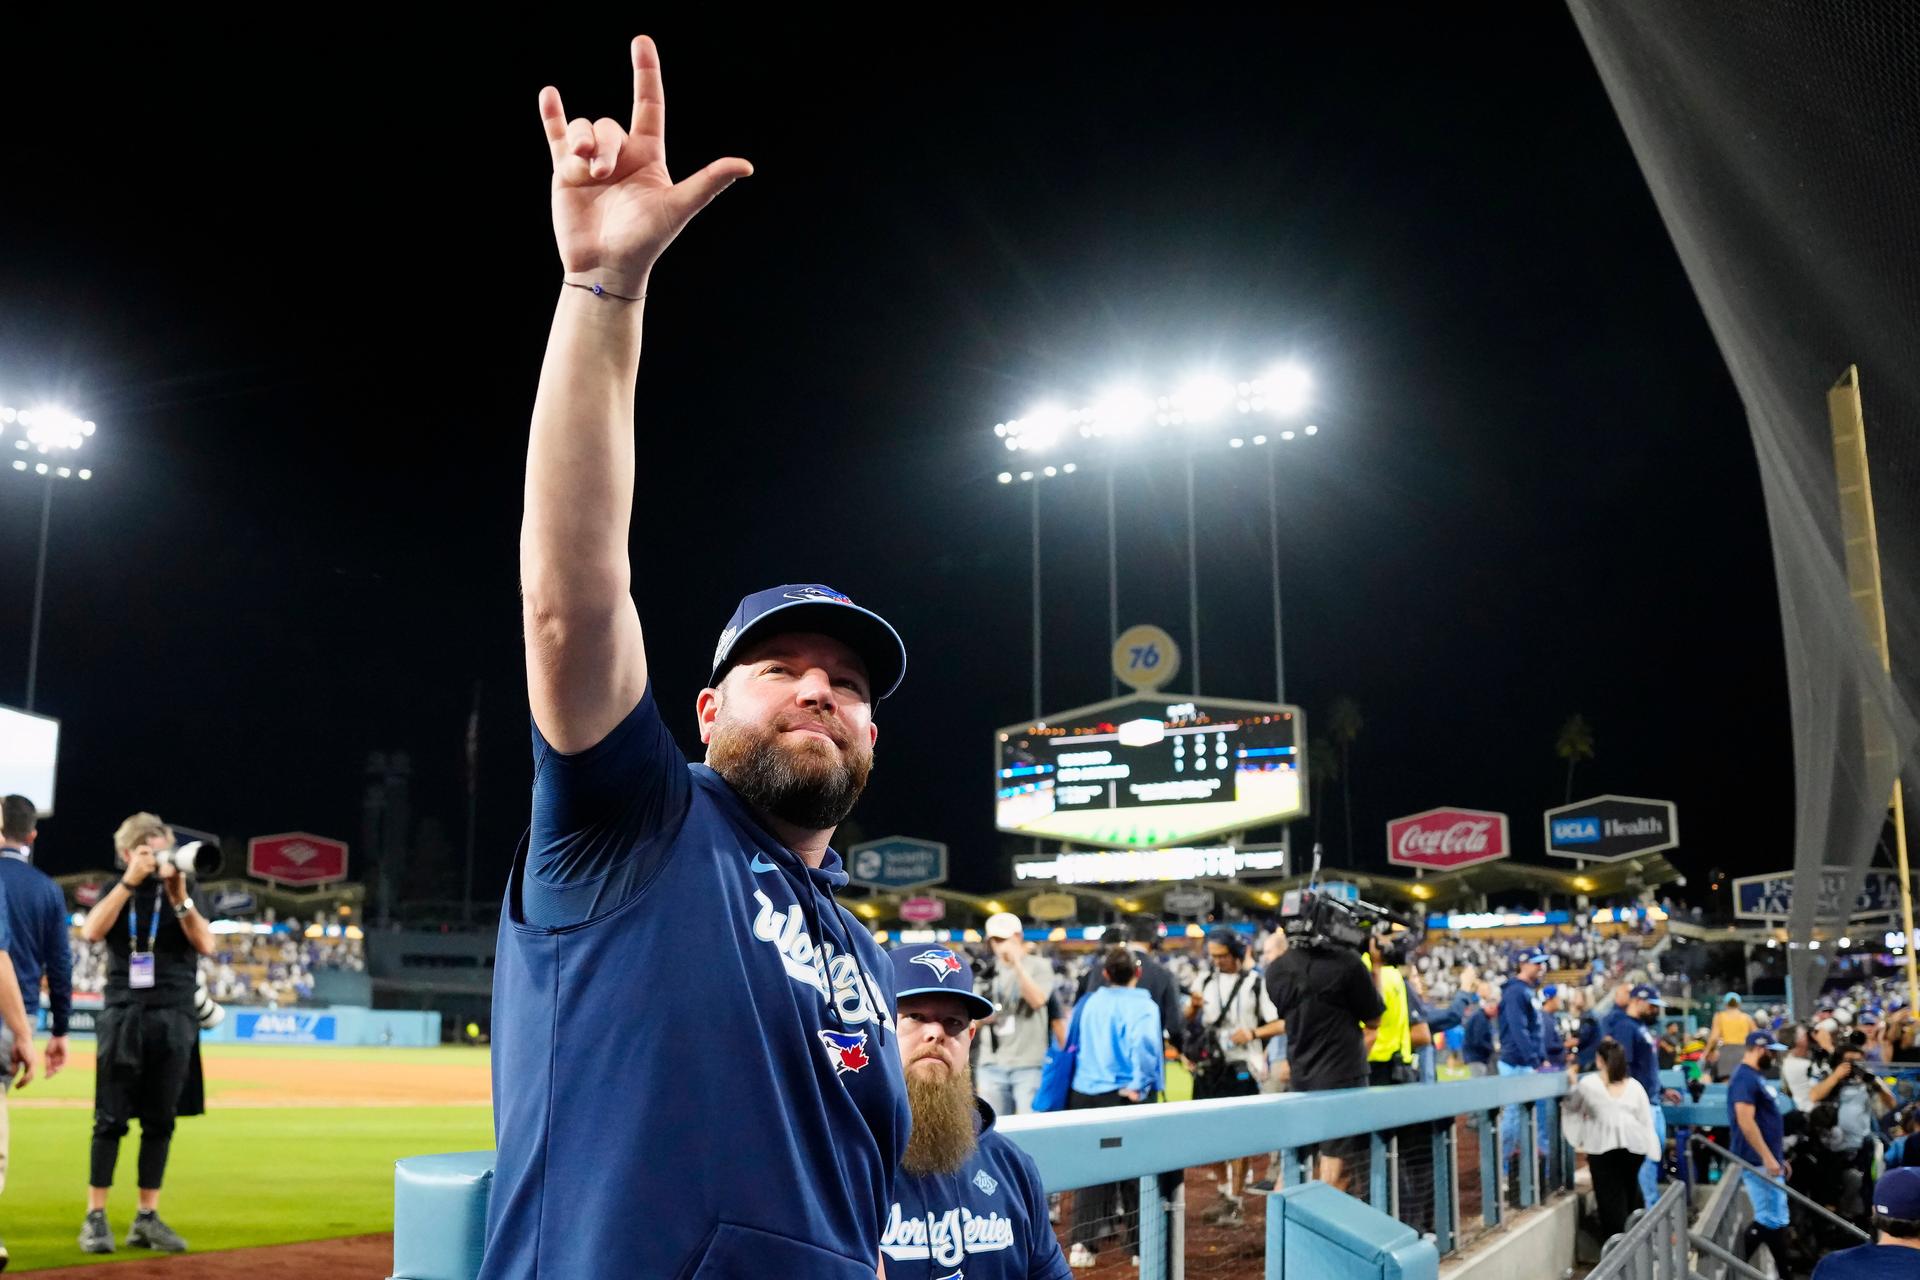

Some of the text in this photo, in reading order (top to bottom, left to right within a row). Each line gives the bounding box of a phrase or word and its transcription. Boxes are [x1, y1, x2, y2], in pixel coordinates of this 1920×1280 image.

[1129, 643, 1160, 669] 76
[1554, 816, 1664, 839] UCLA Health
